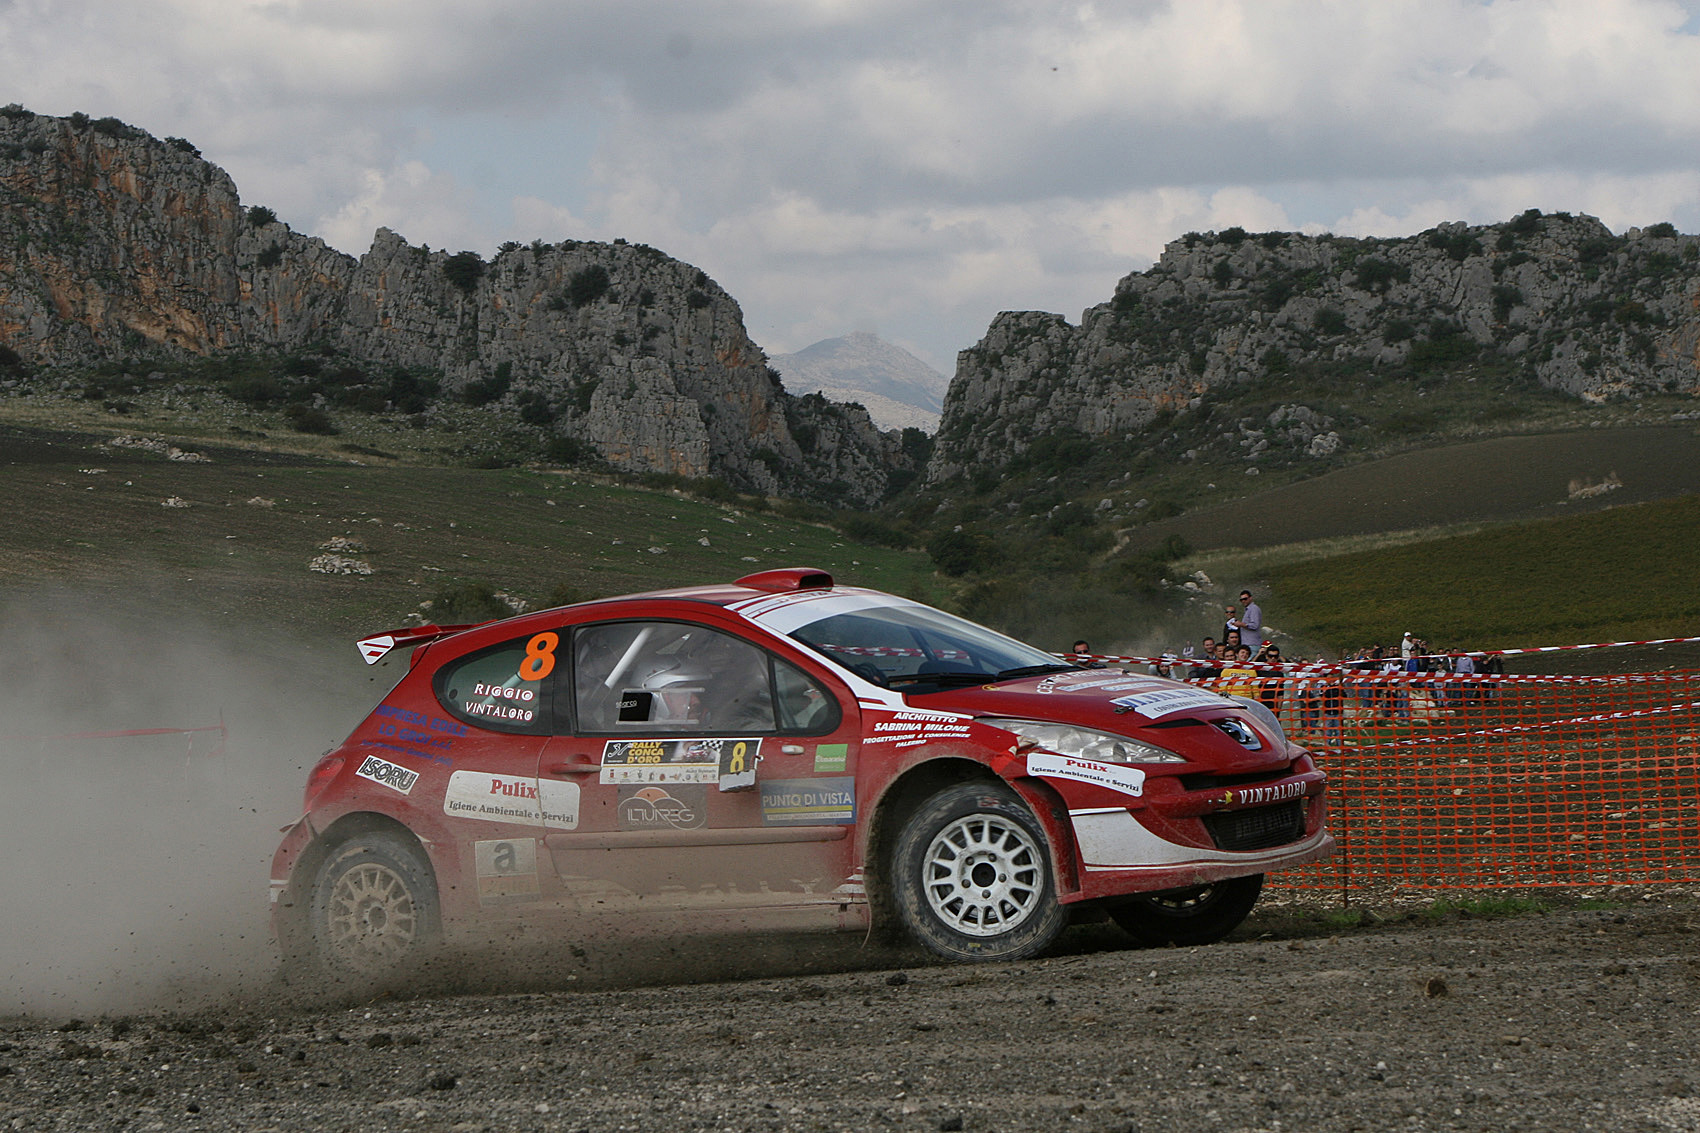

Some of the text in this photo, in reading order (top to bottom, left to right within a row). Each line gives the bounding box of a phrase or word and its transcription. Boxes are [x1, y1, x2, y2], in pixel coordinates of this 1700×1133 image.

[519, 631, 559, 681] 8
[474, 683, 534, 701] RIGGIO
[375, 704, 470, 737] IMPRESA EDILE
[465, 702, 534, 721] VINTALORO
[893, 712, 958, 723] ARCHITETTO
[378, 723, 396, 736] LO
[874, 723, 970, 732] SABRINA MILONE
[862, 734, 916, 744] PROGETTAZIONI
[895, 740, 927, 748] PALERMO
[627, 755, 661, 764] D'ORO
[628, 748, 664, 756] CONCA
[730, 742, 747, 774] 8
[358, 756, 418, 791] ISORU
[1065, 759, 1109, 772] Pulix
[490, 779, 537, 799] Pulix
[1058, 769, 1105, 782] Ambientale
[1111, 779, 1140, 791] Servizi
[762, 792, 853, 807] PUNTO DI VISTA
[1239, 780, 1307, 804] VINTALORO
[449, 800, 477, 812] Igiene
[479, 804, 533, 818] Ambientale
[541, 811, 574, 823] Servizi
[494, 842, 516, 873] a
